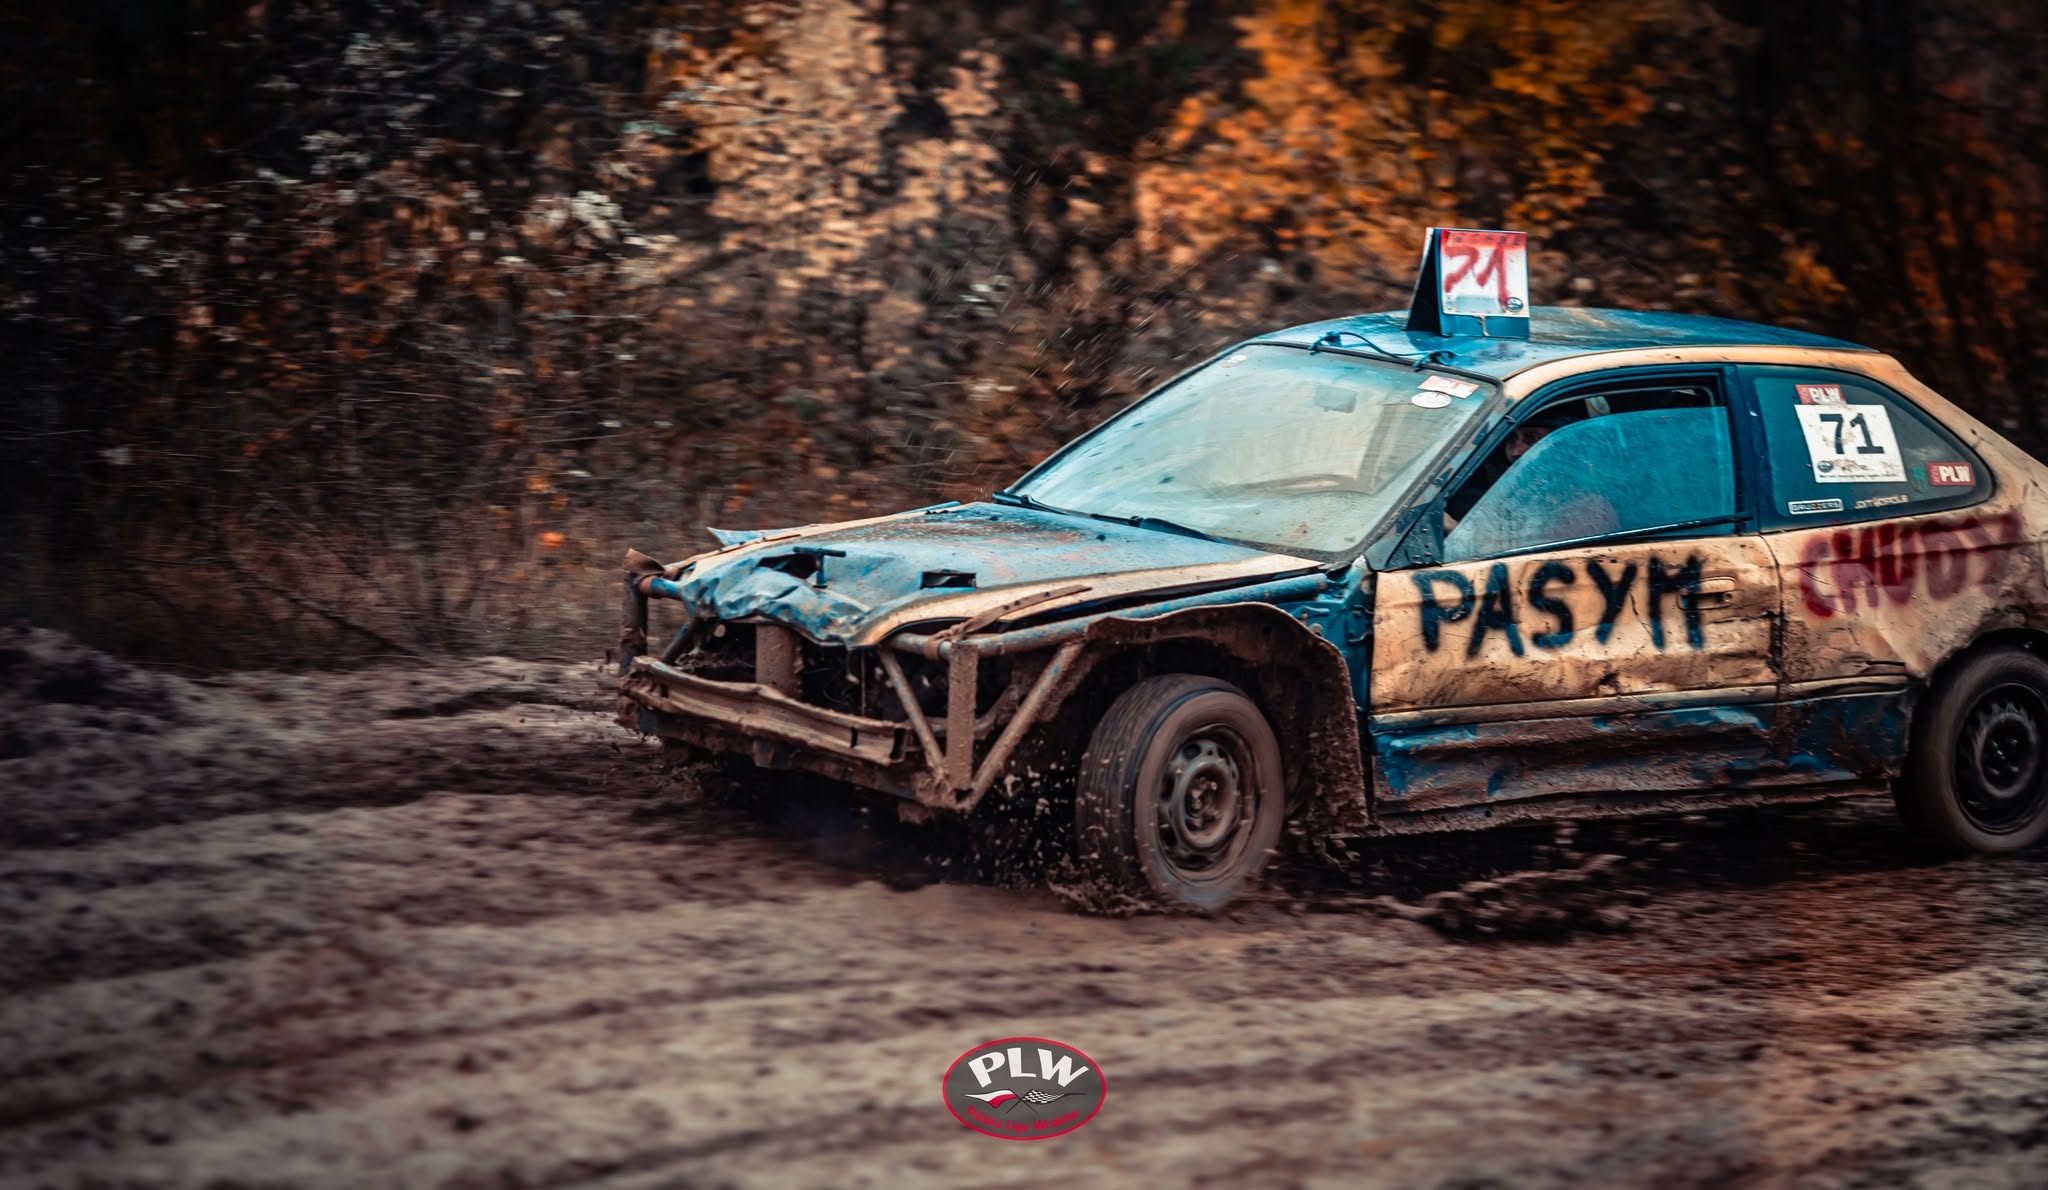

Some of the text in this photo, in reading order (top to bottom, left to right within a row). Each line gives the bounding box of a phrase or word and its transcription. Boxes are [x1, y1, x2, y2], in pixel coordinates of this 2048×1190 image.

[1819, 413, 1885, 454] 71
[1938, 465, 1971, 482] PLW
[1412, 553, 1706, 658] PASYM
